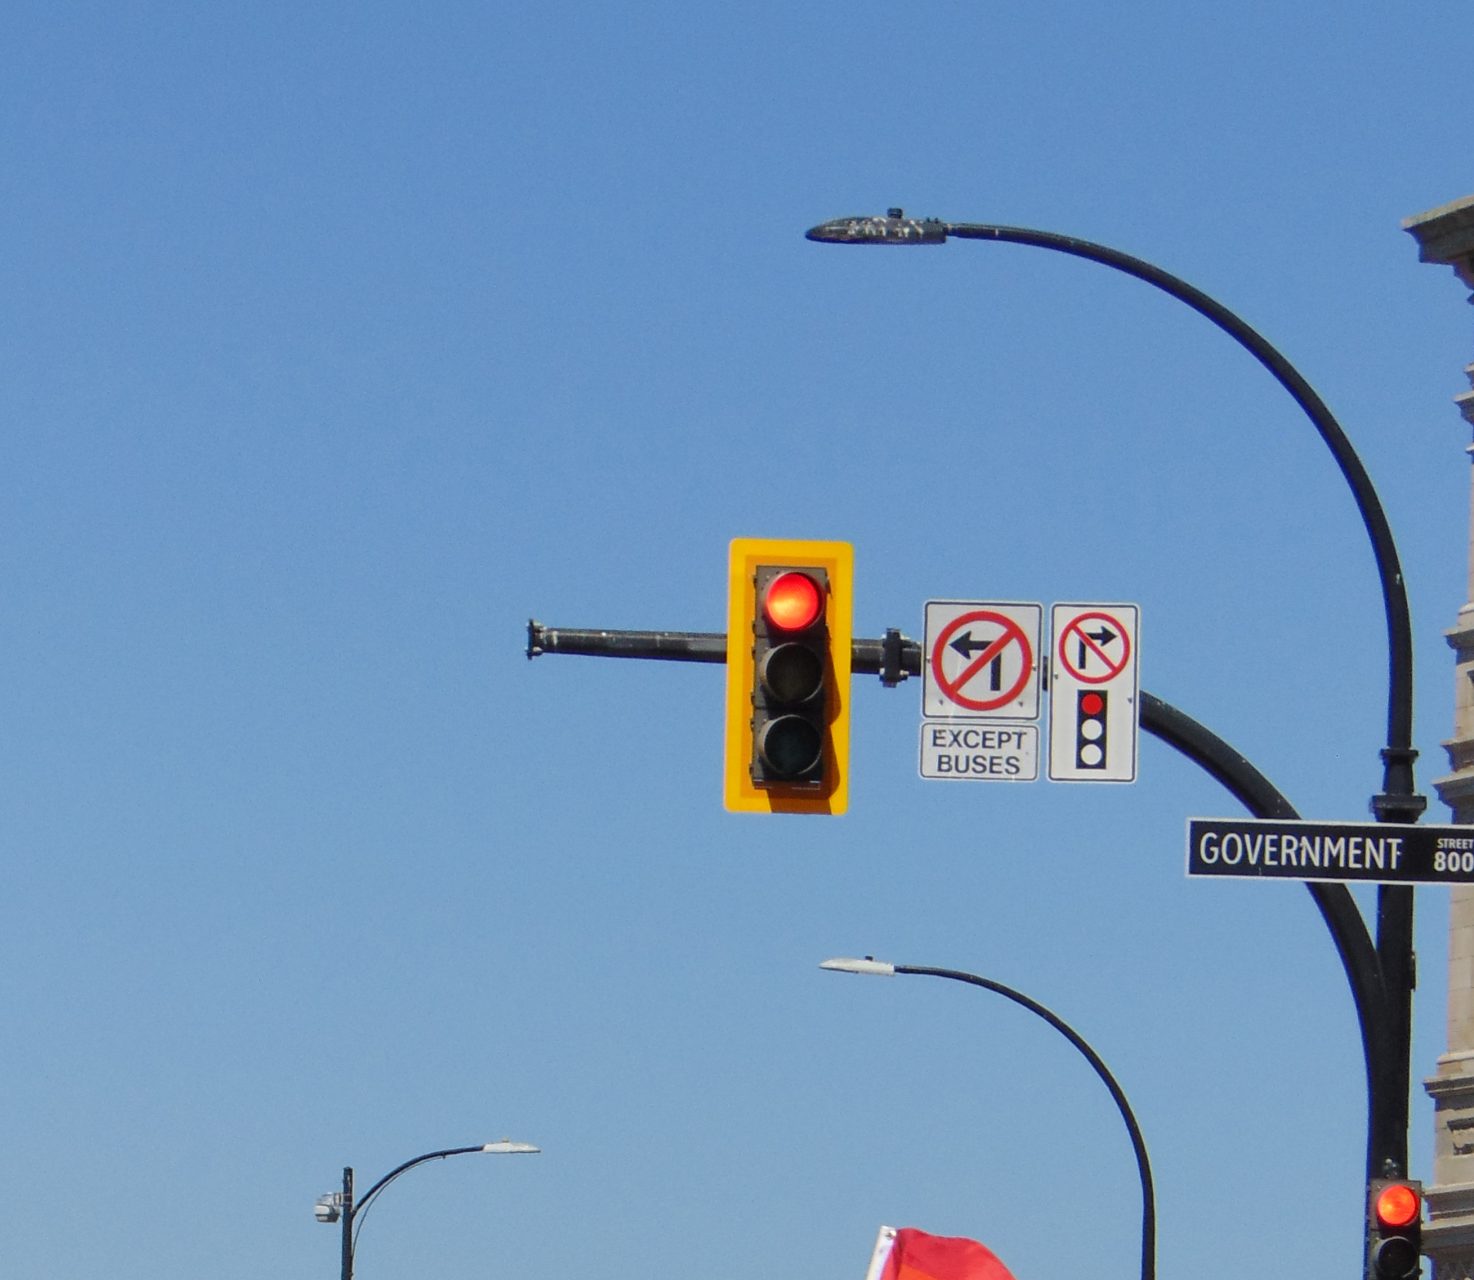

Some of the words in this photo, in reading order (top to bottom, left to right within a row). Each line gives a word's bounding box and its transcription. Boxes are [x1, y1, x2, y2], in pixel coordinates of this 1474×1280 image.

[932, 729, 1027, 750] EXCEPT
[937, 754, 1020, 775] BUSES
[1199, 832, 1402, 870] GOVERNMENT
[1436, 838, 1474, 849] STREET
[1433, 851, 1474, 873] 800
